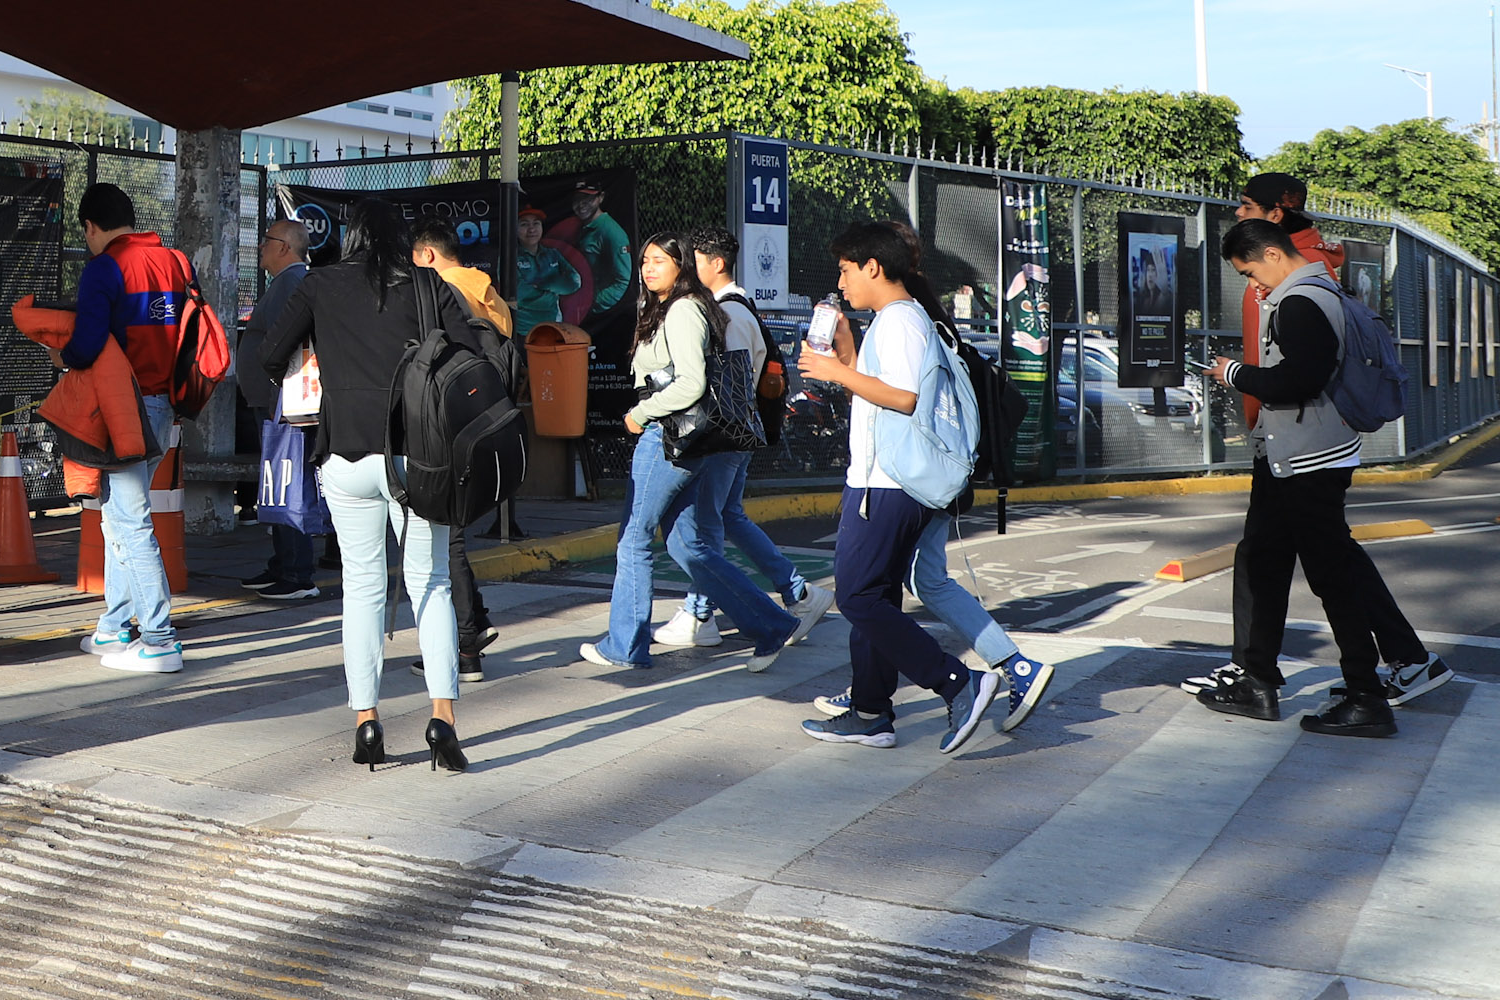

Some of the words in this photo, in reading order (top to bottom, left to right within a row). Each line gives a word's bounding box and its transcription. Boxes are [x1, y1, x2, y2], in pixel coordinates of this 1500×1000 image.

[751, 154, 780, 168] PUERTA
[751, 176, 781, 213] 14
[755, 288, 778, 301] BUAP
[934, 407, 961, 430] adidas
[257, 458, 292, 507] AP
